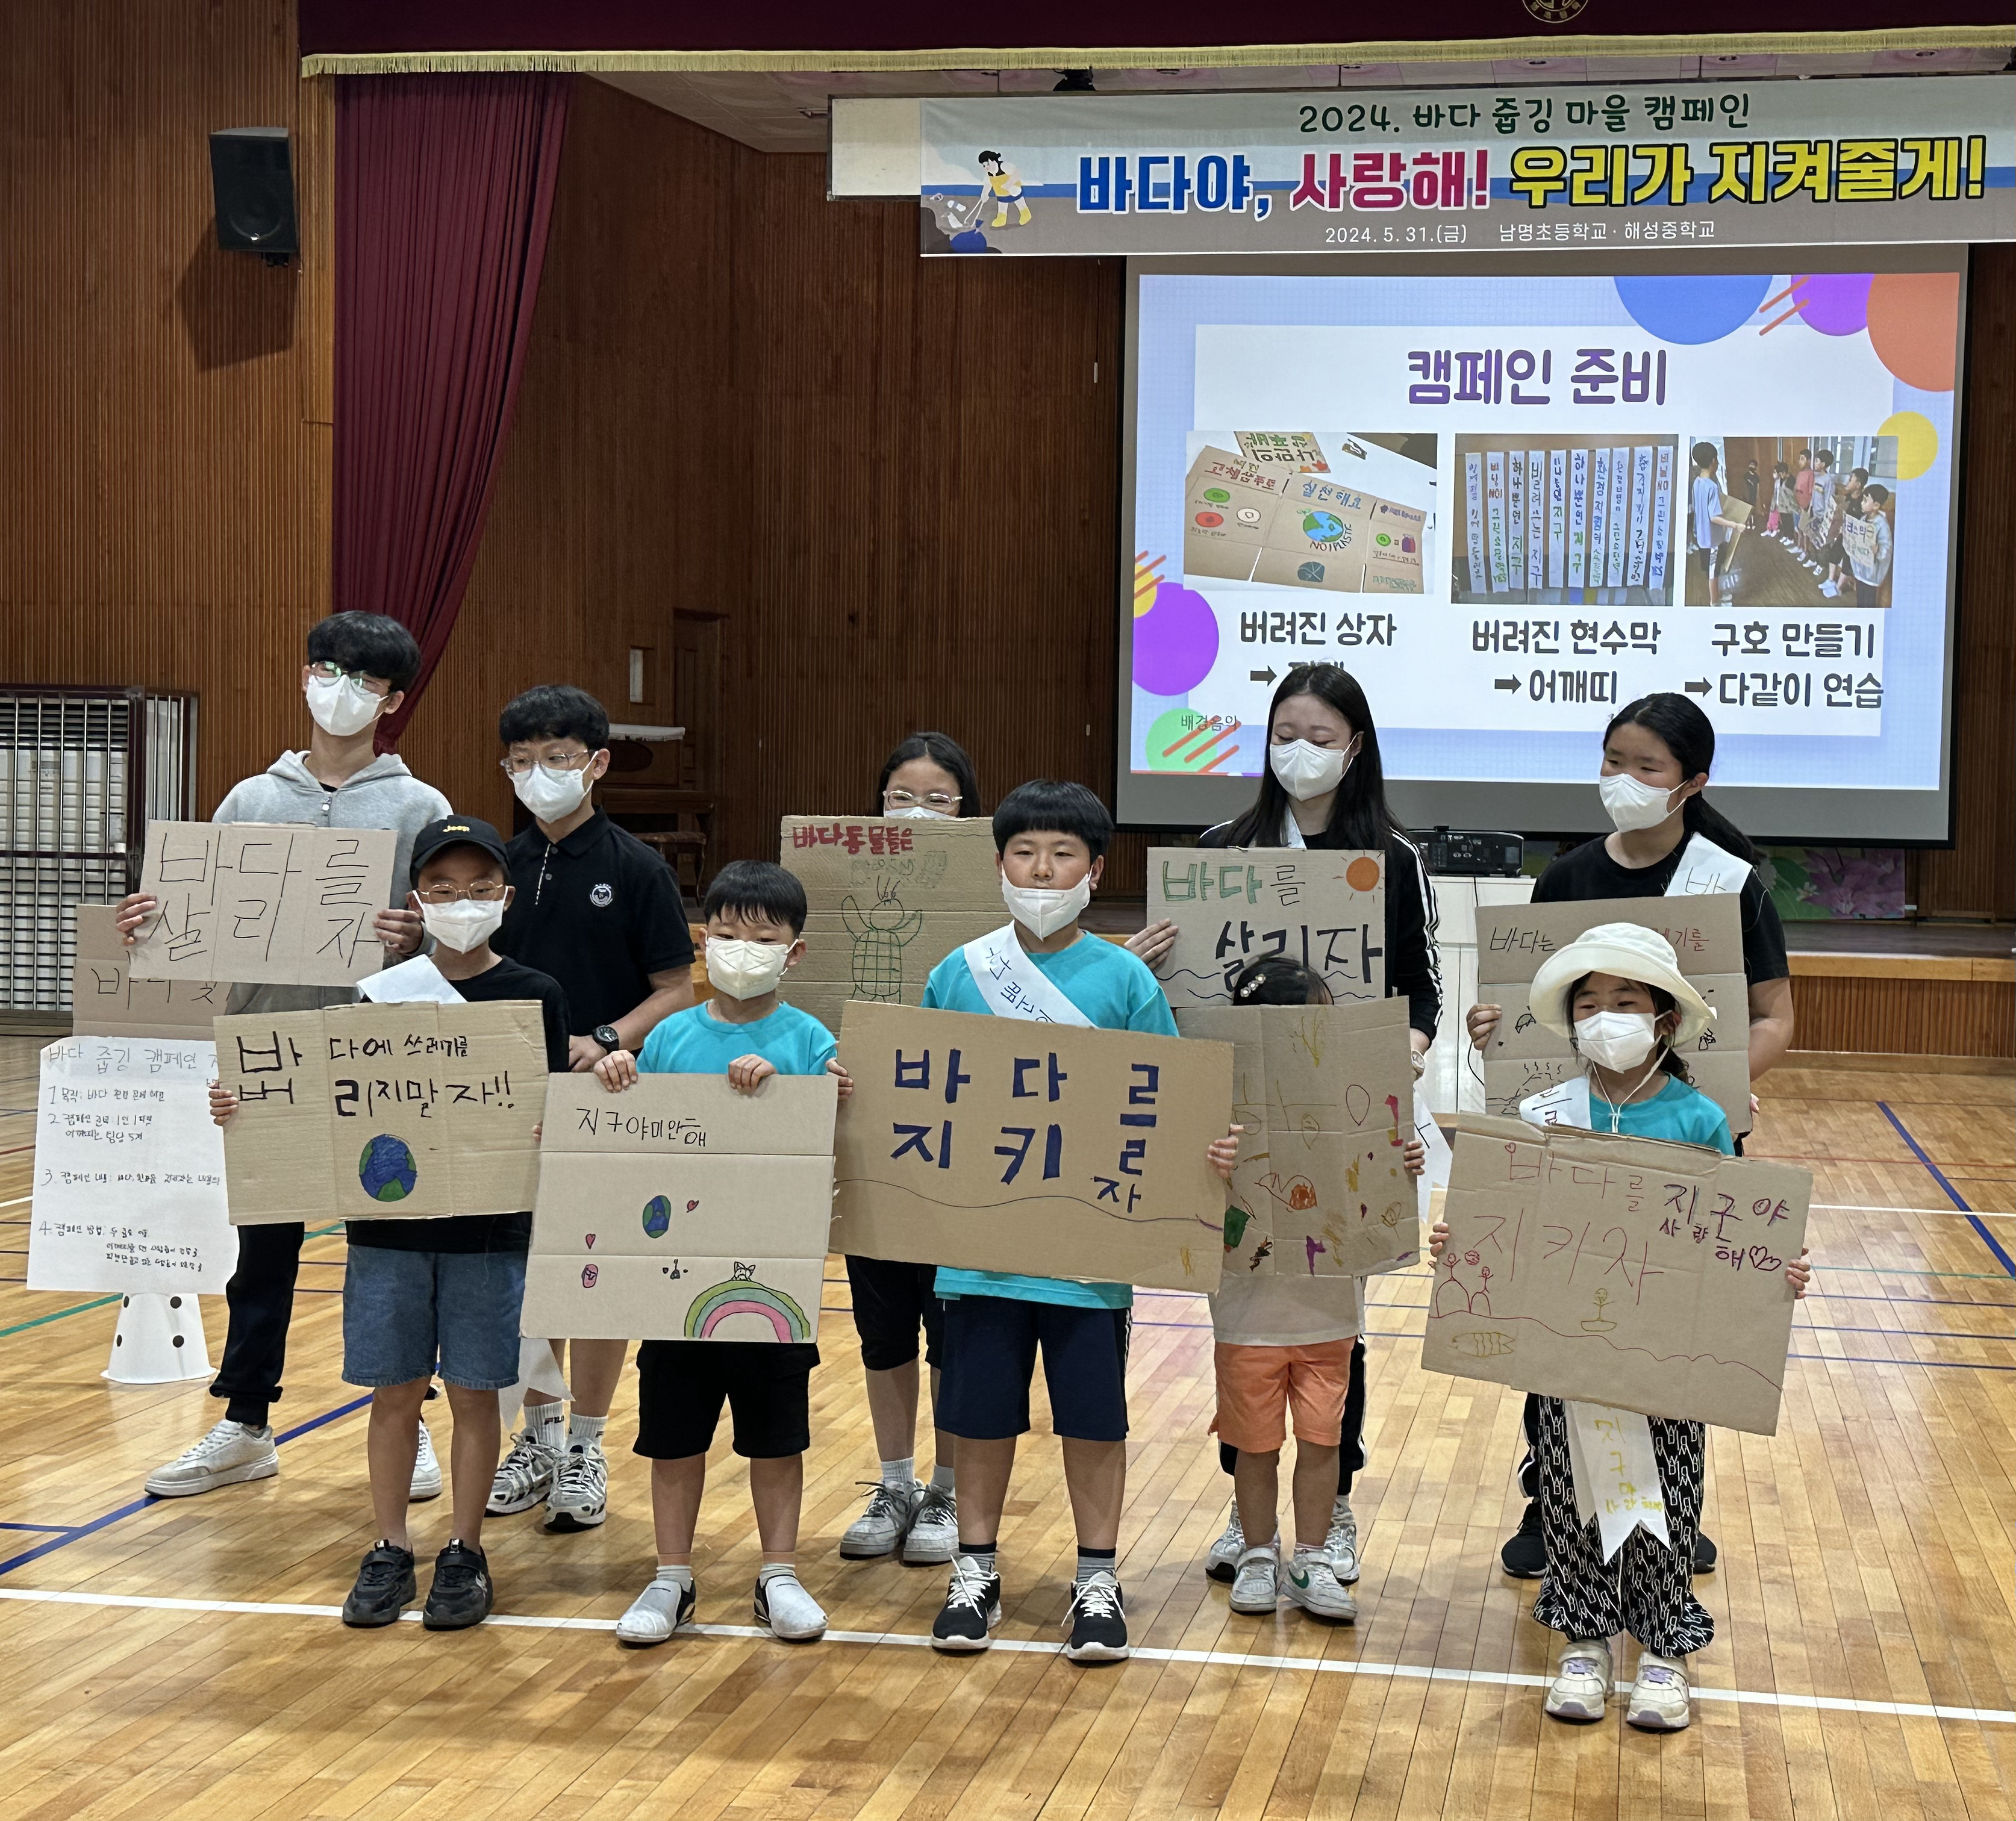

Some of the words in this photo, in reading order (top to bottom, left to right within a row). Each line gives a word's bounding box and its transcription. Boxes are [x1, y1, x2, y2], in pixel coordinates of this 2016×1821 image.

[1299, 104, 1400, 133] 2024.
[1412, 102, 1481, 128] 바다
[1492, 97, 1553, 134] 줍깅
[1565, 94, 1631, 132] 마을
[1644, 93, 1749, 130] 캠페인
[1077, 152, 1272, 220] 바다야,
[1290, 147, 1490, 211] 사랑해!
[1509, 144, 1694, 208] 우리가
[1708, 135, 1986, 205] 지켜줄게!
[1624, 221, 1715, 240] 해성중학교
[1408, 348, 1550, 405] 캠페인
[1570, 348, 1667, 406] 준비
[1240, 611, 1326, 645] 버려진
[1336, 612, 1397, 646] 상자
[1472, 620, 1559, 655] 버려진
[1570, 618, 1661, 655] 현수막
[1711, 621, 1770, 657] 구호
[1781, 623, 1875, 658] 만들기
[1529, 670, 1617, 703] 어깨띠
[1719, 673, 1811, 707] 다같이
[1824, 673, 1884, 708] 연습
[160, 830, 373, 906] 바다를
[1163, 861, 1306, 906] 바다를
[149, 893, 381, 968] 살리자
[49, 1044, 84, 1062] 바다
[96, 1046, 130, 1074] 줍깅
[87, 1089, 108, 1100] 바다
[894, 1048, 1160, 1175] 바다를
[891, 1119, 1141, 1213] 지키자
[1506, 1142, 1644, 1212] 바다를
